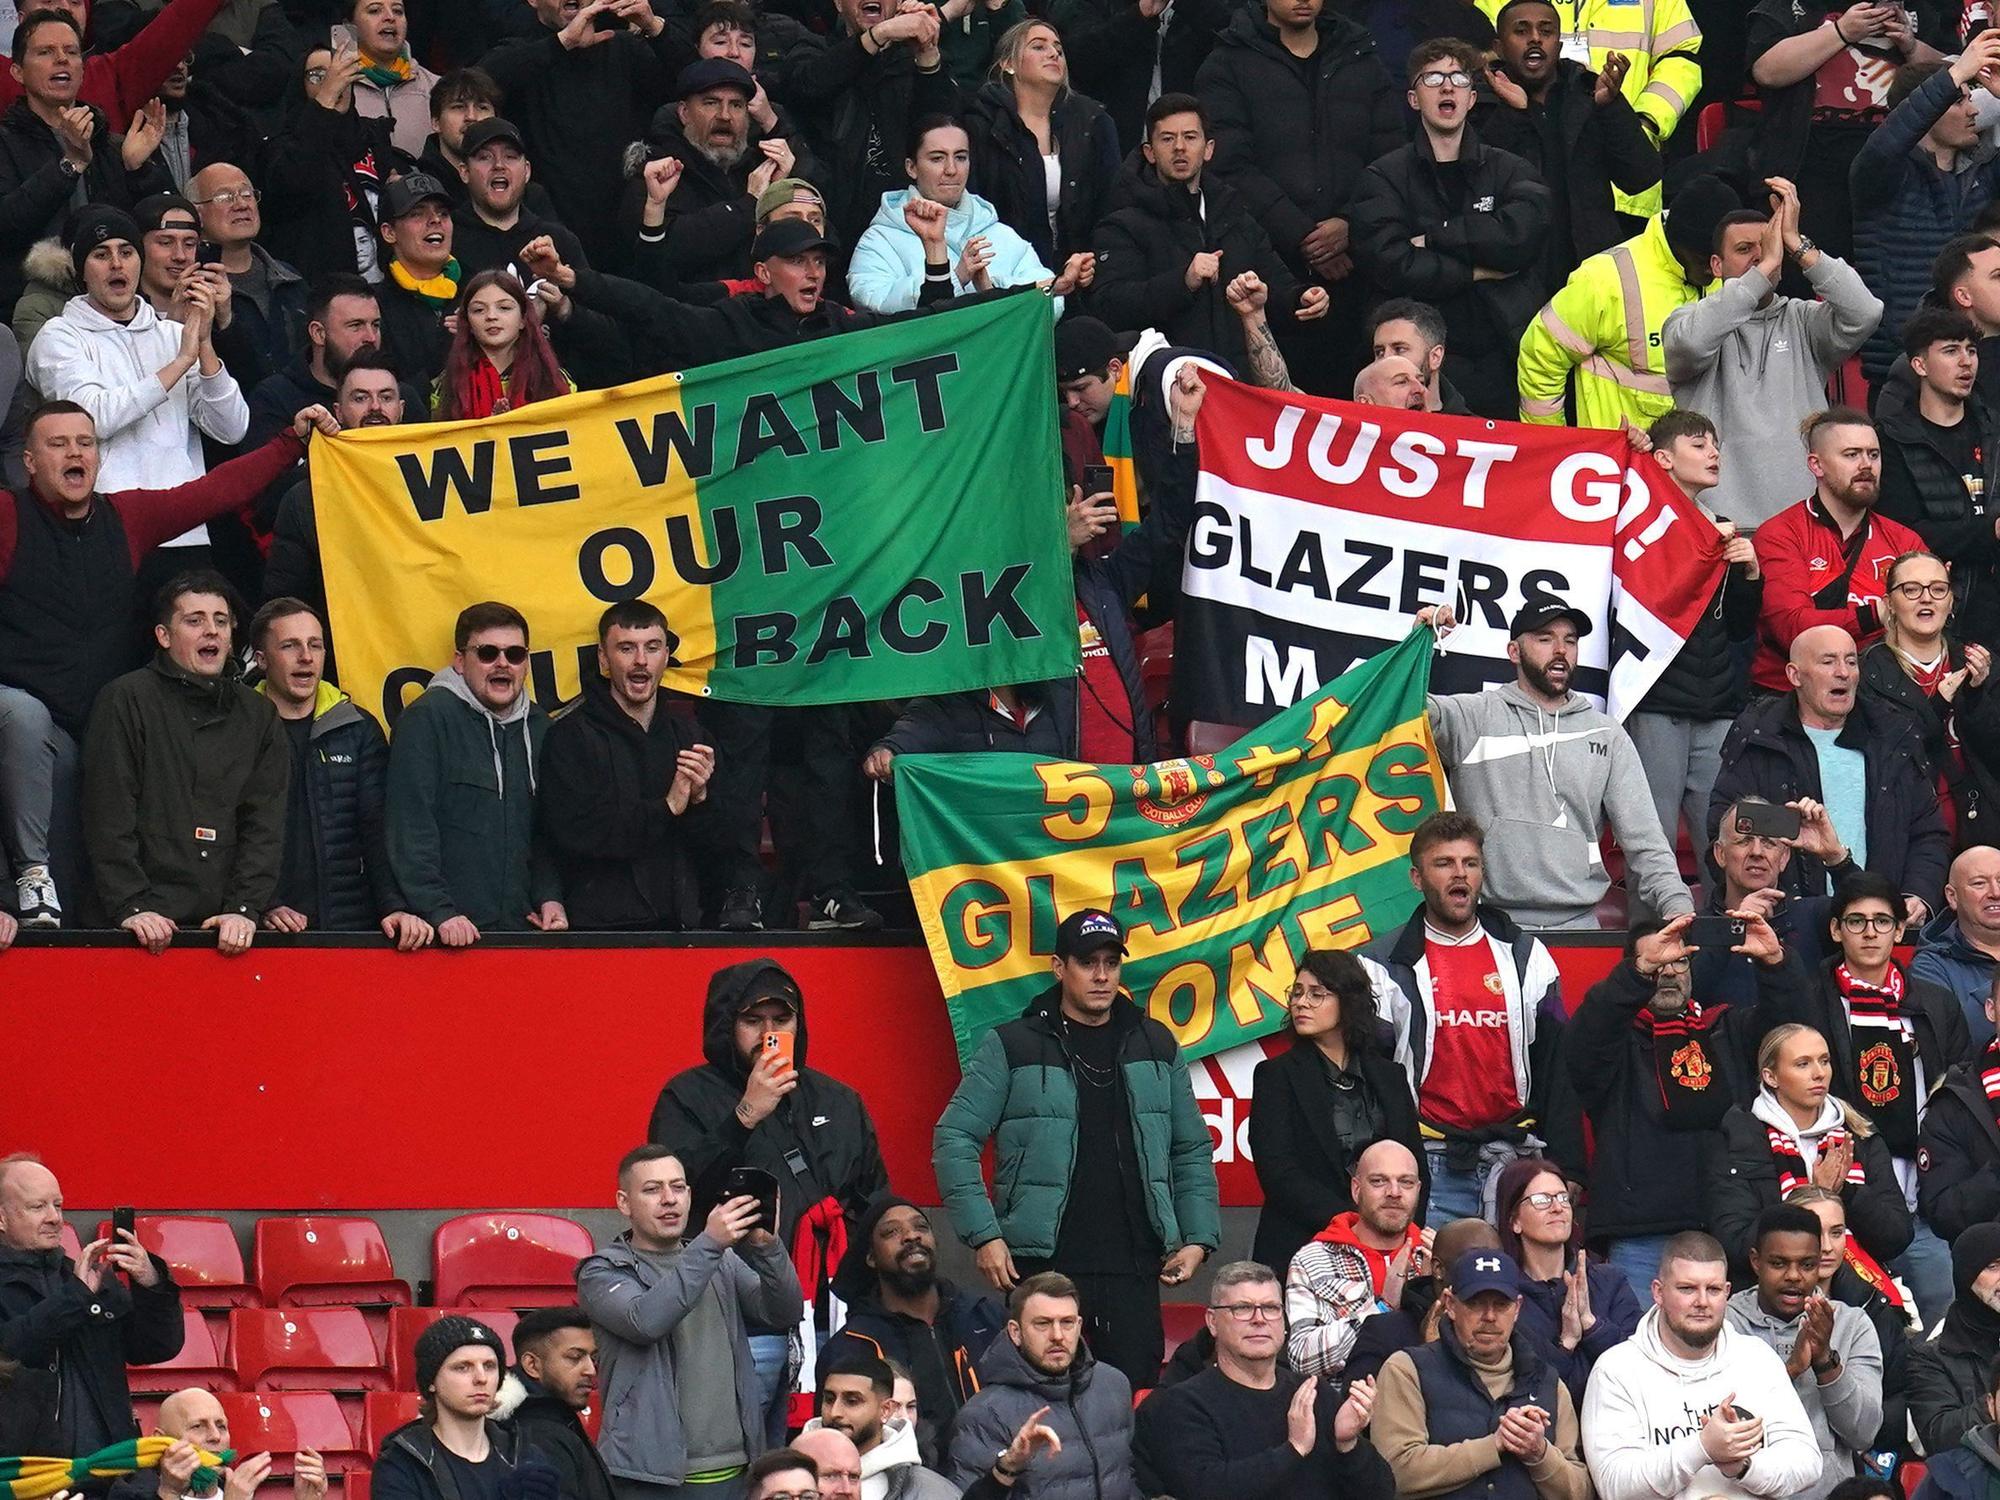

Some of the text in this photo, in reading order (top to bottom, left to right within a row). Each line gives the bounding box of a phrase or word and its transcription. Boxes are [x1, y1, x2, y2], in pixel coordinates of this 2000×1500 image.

[396, 351, 960, 522] WE WANT
[1245, 404, 1518, 509] JUST
[577, 495, 835, 603] OUR
[1188, 500, 1571, 632] GLAZERS
[734, 562, 1044, 669] BACK
[1034, 761, 1116, 842] 5
[1589, 741, 1607, 757] TM
[940, 742, 1436, 969] GLAZERS
[1141, 793, 1208, 822] FOOTBALL CLU
[1121, 894, 1372, 1048] ONE
[1434, 1008, 1508, 1028] HARP
